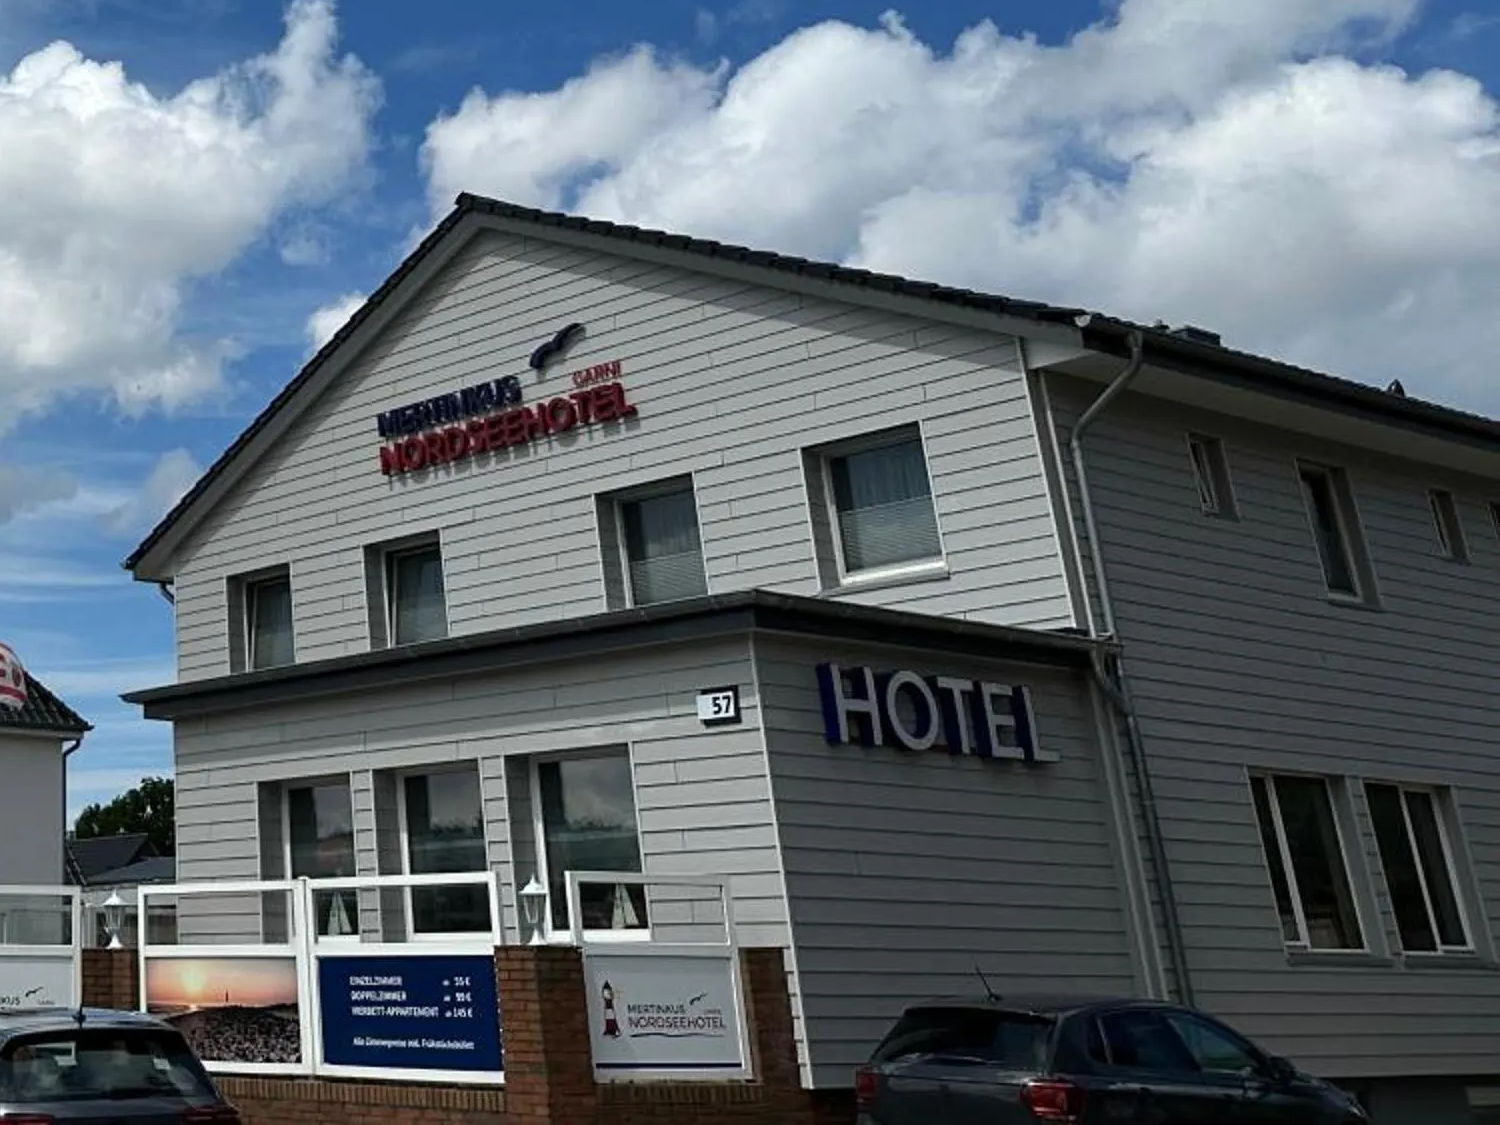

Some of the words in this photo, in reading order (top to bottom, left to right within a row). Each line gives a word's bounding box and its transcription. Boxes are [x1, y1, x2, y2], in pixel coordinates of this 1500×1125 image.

[572, 360, 624, 388] GARNI
[378, 382, 639, 476] NORDSEEHOTEL
[712, 695, 732, 715] 57
[816, 662, 1061, 762] HOTEL
[628, 1016, 726, 1028] NORDSEEHOTEL
